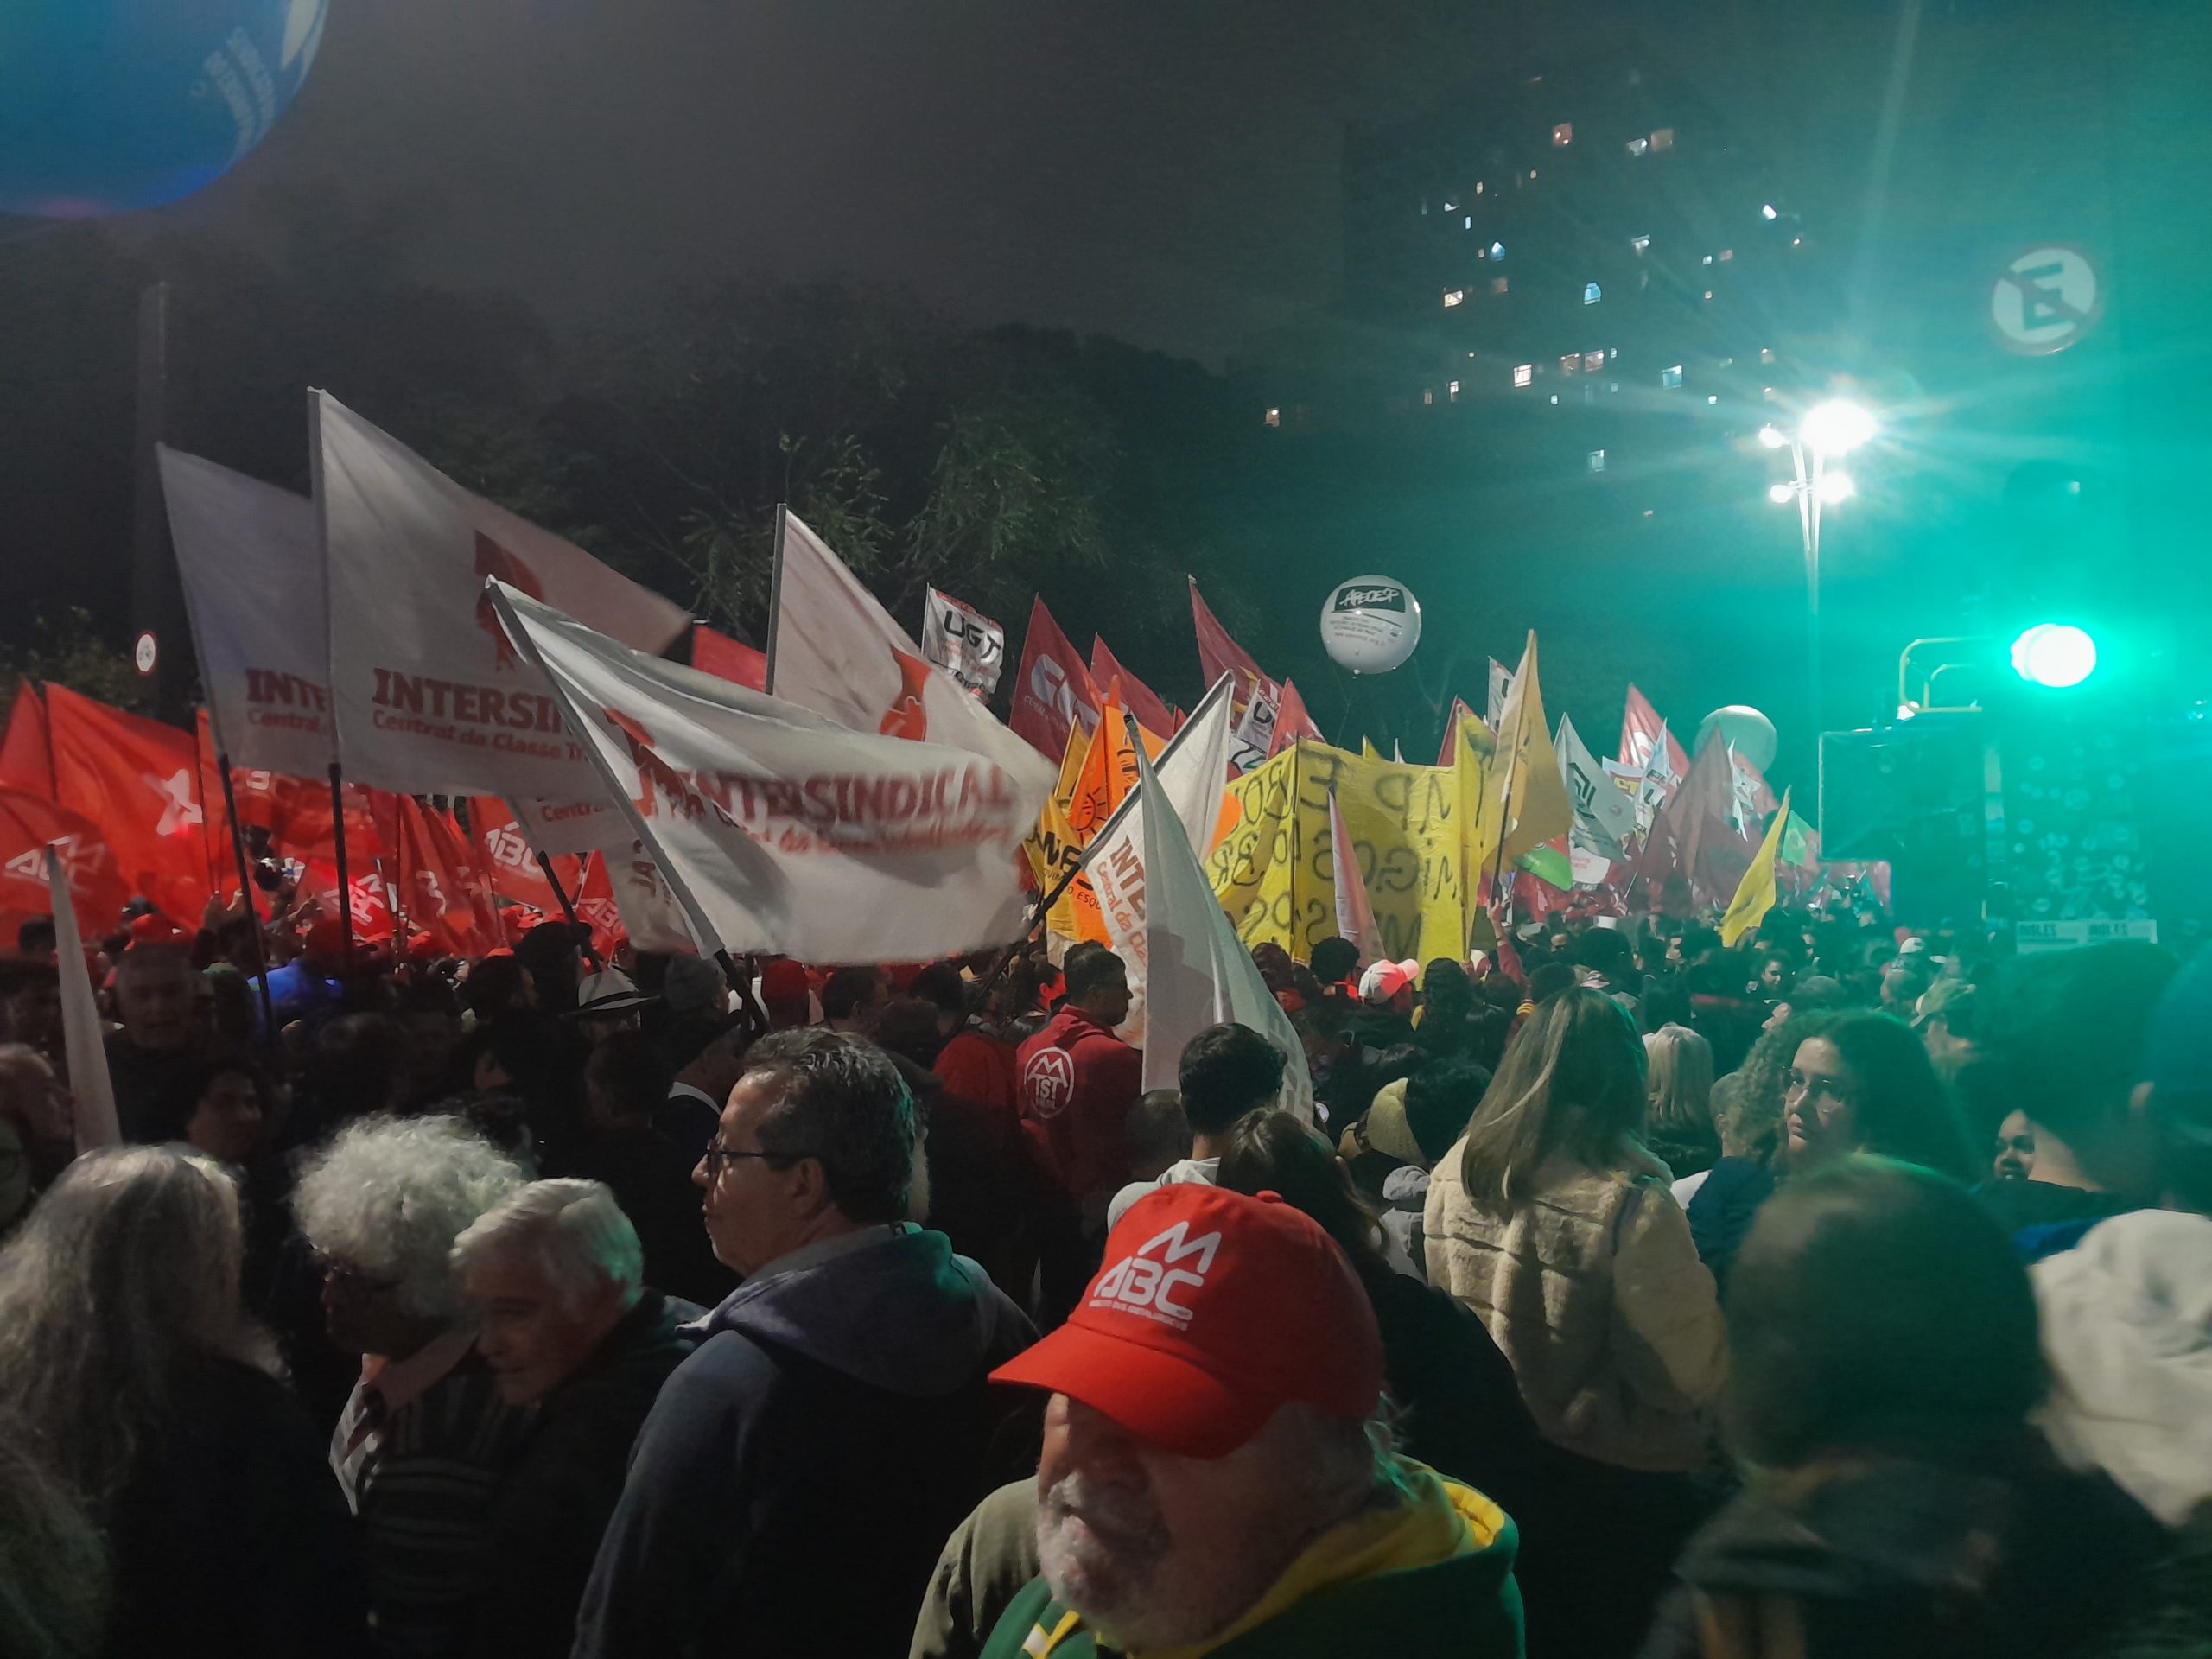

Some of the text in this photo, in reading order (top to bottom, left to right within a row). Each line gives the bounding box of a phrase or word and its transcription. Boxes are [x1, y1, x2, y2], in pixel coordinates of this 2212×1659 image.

[2022, 262, 2075, 330] E
[944, 609, 1002, 659] UGT
[372, 709, 456, 741] Central
[1093, 1255, 1205, 1321] ABC
